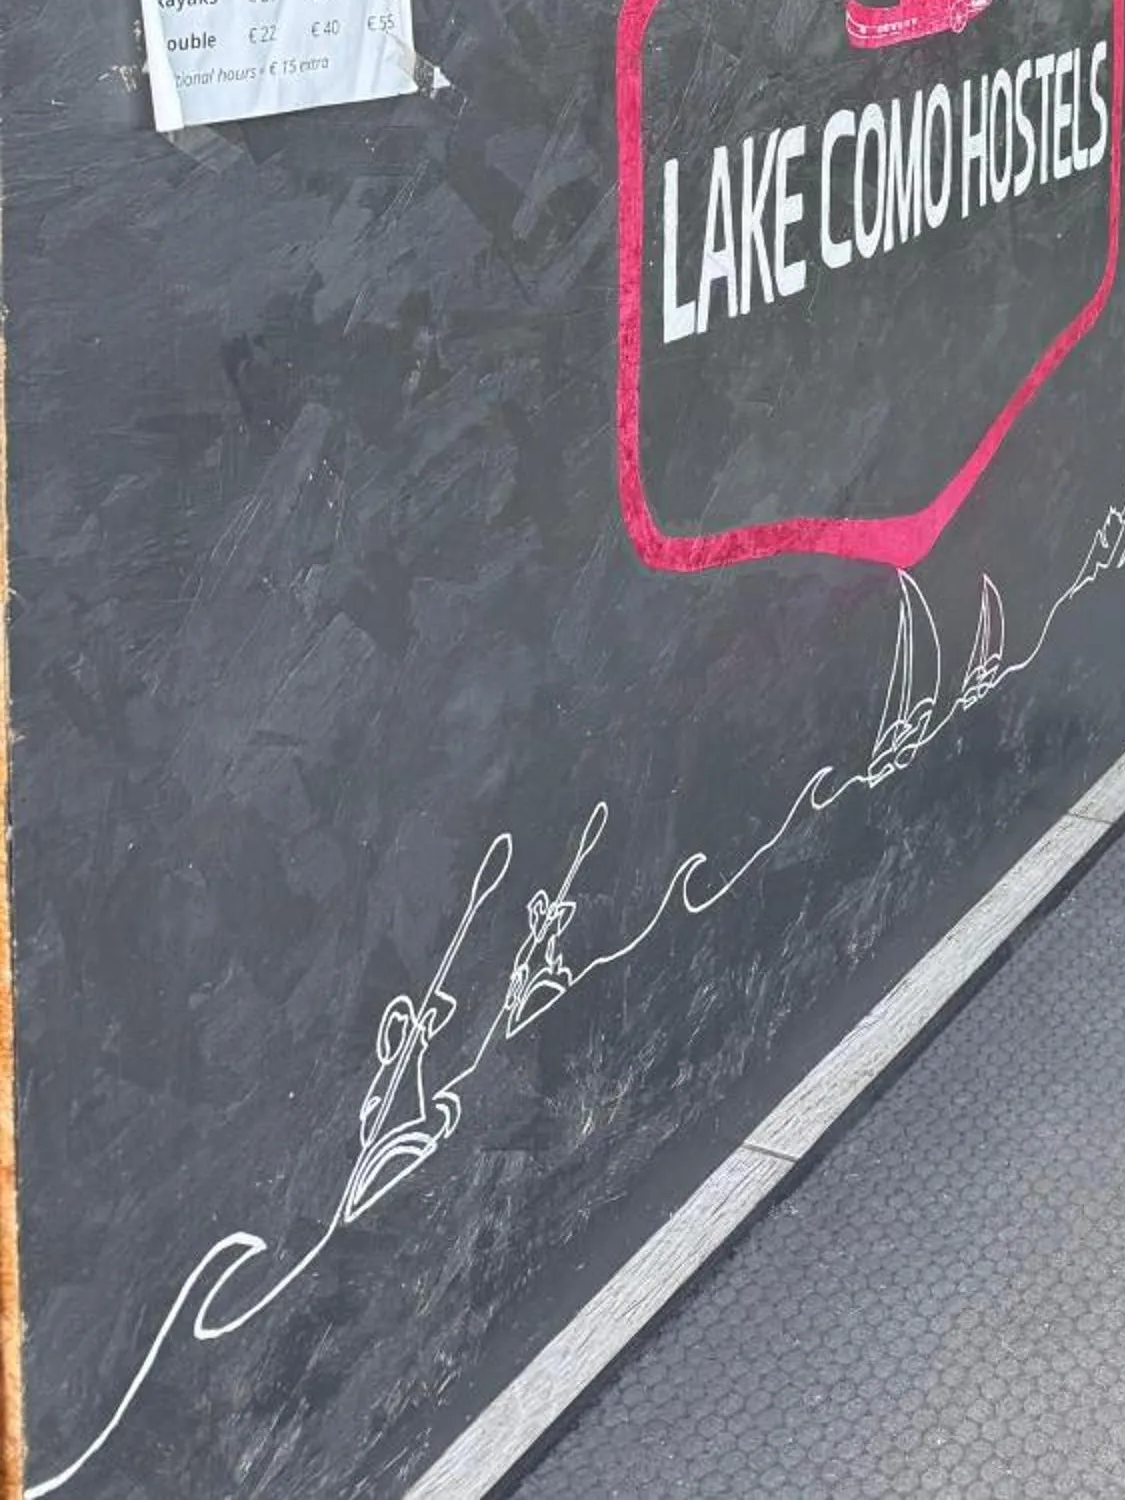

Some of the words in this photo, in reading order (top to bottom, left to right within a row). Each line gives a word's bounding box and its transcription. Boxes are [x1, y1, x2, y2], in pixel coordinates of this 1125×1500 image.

[217, 67, 257, 83] hours
[663, 125, 806, 343] LAKE
[819, 83, 952, 269] COMO
[961, 40, 1109, 219] HOSTELS
